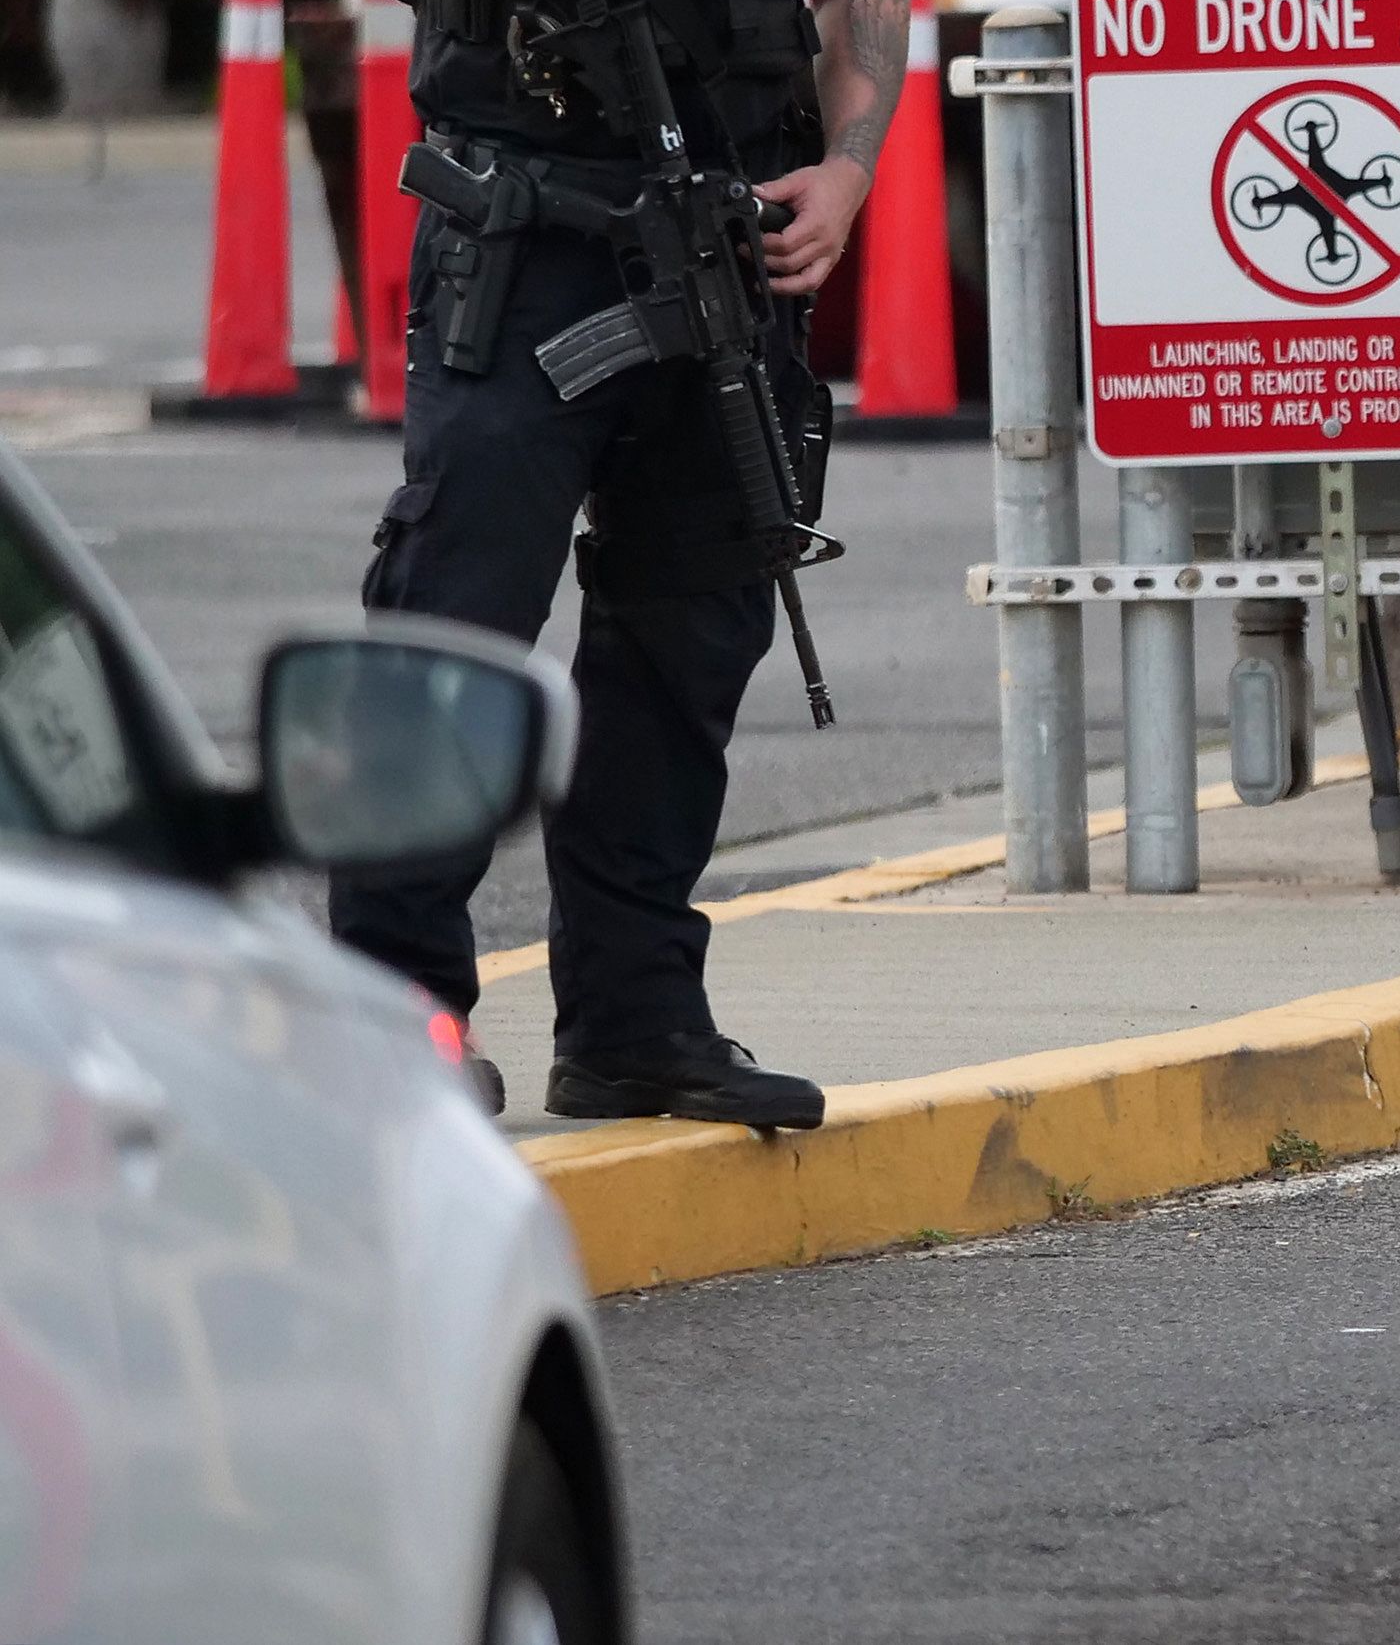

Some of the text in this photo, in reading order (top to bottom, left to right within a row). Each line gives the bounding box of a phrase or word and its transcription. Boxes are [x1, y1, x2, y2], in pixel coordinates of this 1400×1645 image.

[1151, 338, 1266, 368] LAUNCHING,
[1273, 335, 1359, 364] LANDING
[1367, 334, 1395, 362] OR
[1099, 371, 1206, 402] UNMANNED
[1214, 370, 1242, 397] OR
[1251, 368, 1328, 396] REMOTE
[1190, 402, 1212, 429] IN
[1220, 400, 1263, 427] THIS
[1271, 399, 1325, 426] AREA
[1331, 397, 1352, 425] IS
